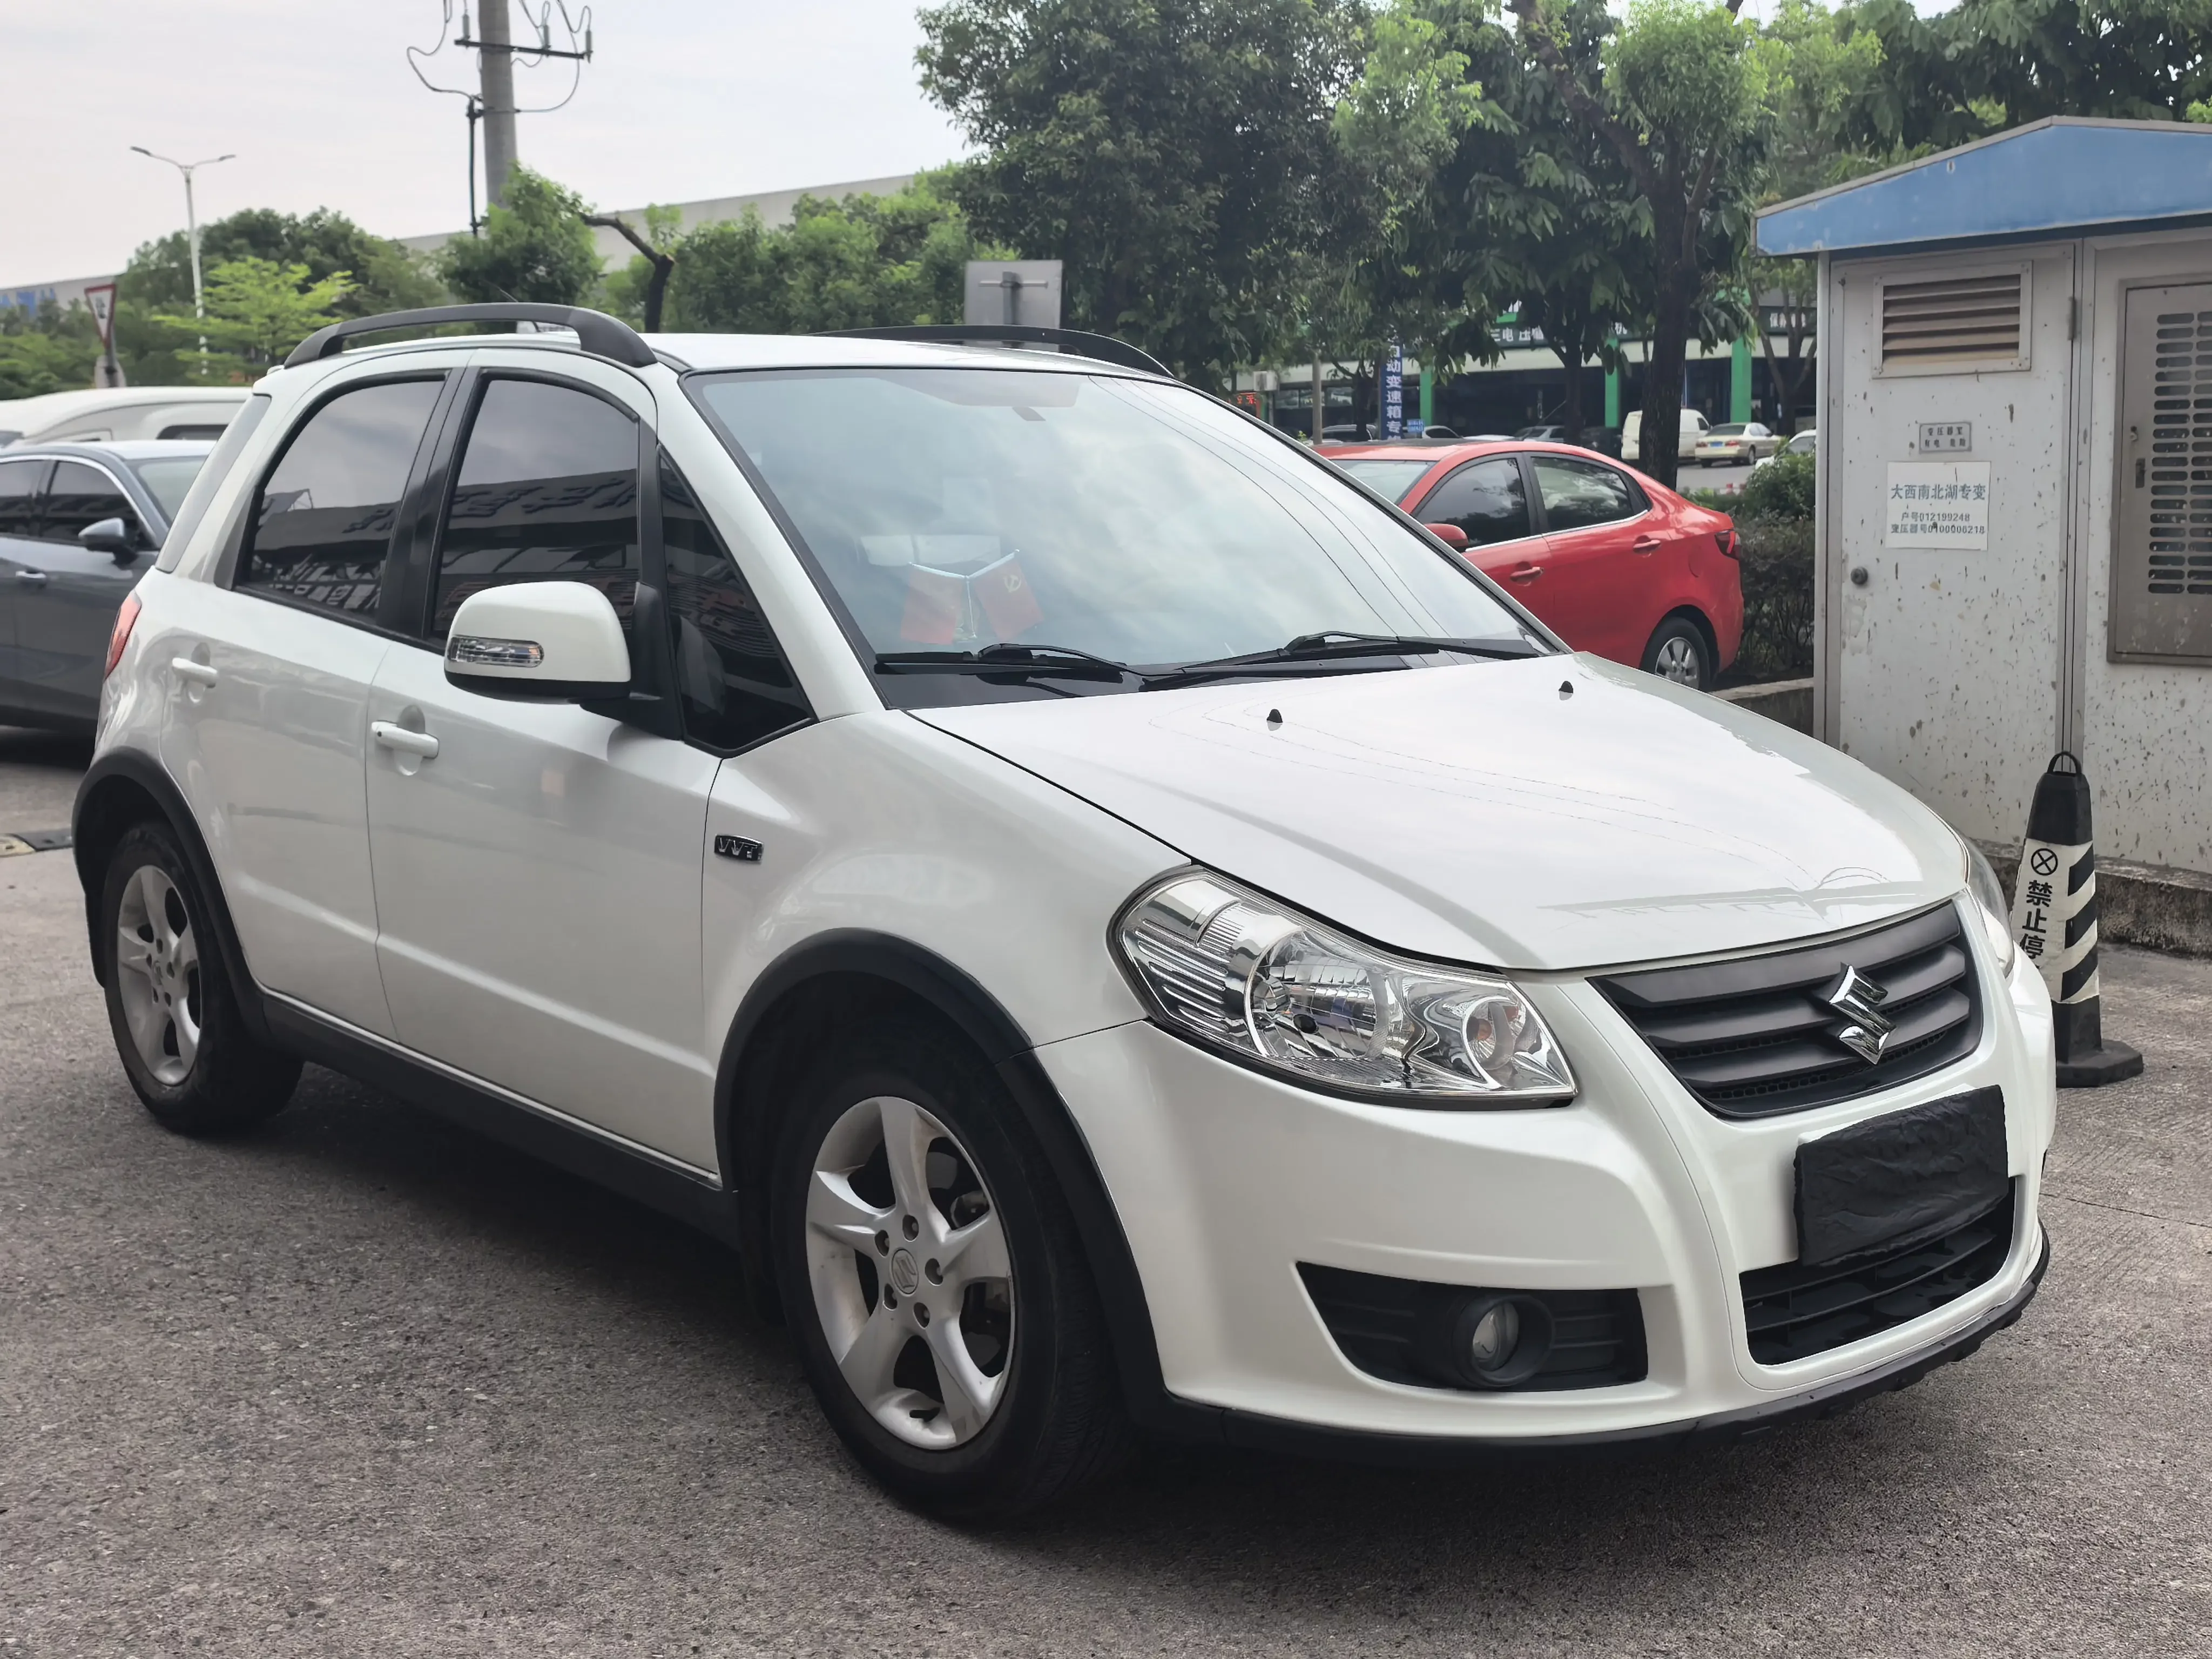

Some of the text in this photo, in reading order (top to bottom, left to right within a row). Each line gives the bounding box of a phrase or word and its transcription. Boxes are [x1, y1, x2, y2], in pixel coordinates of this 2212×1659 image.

[1891, 483, 1986, 501] 大西南北湖专变
[2019, 879, 2052, 970] 禁止停
